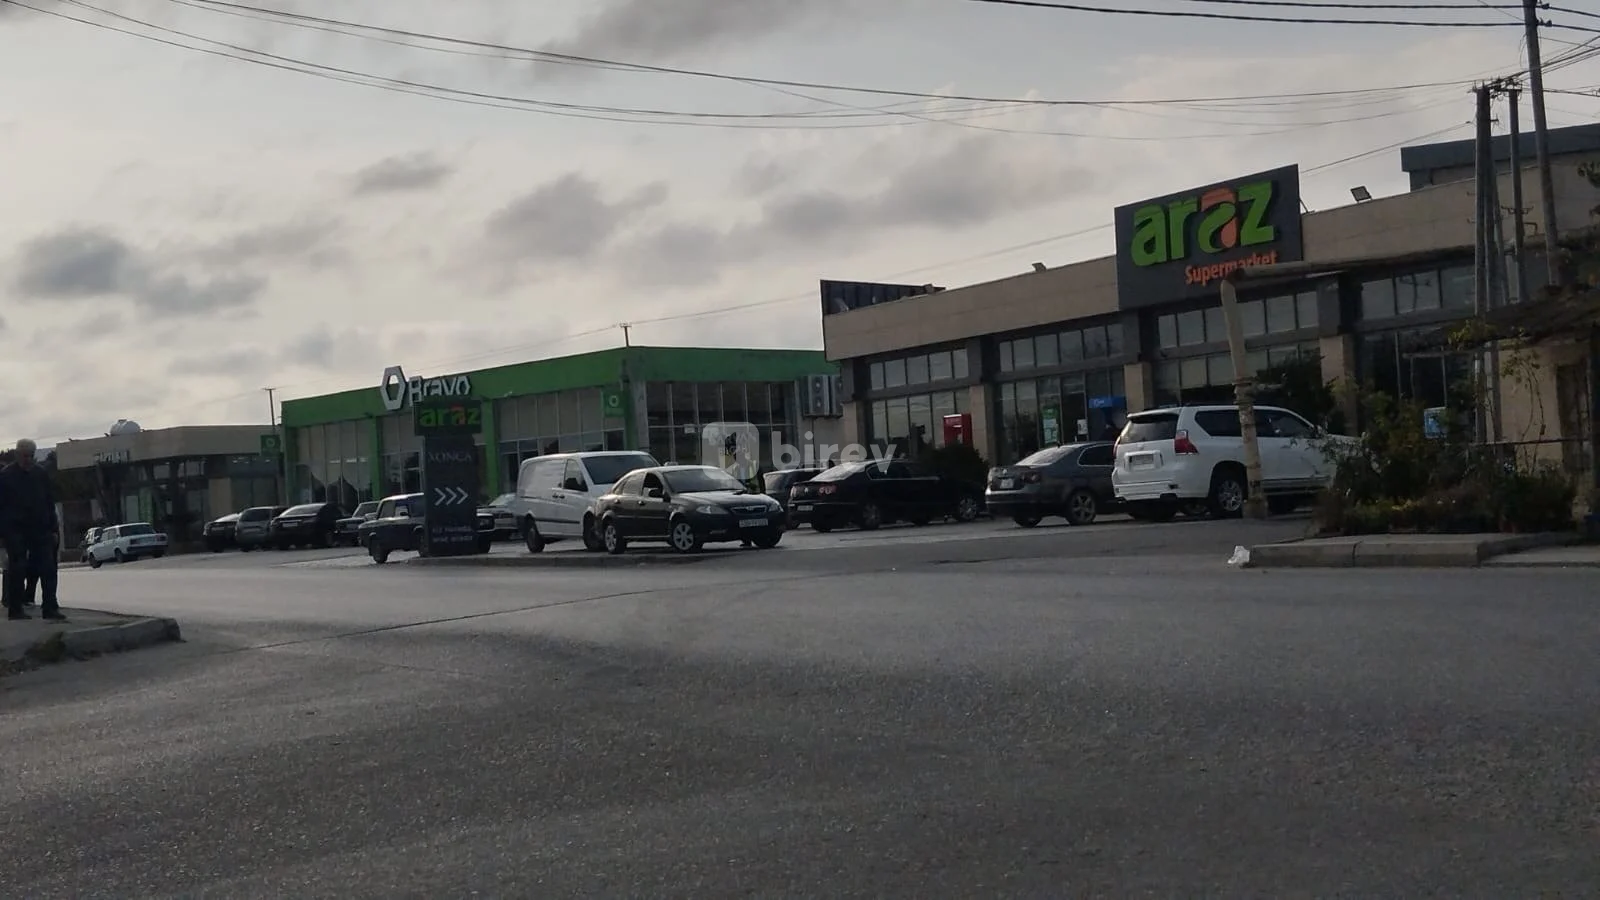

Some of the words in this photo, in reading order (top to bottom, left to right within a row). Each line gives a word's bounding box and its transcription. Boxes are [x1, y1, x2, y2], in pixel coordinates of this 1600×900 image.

[1132, 181, 1274, 266] araz
[1185, 251, 1279, 286] Supermarket
[408, 376, 471, 406] Bravo
[420, 405, 481, 426] araz
